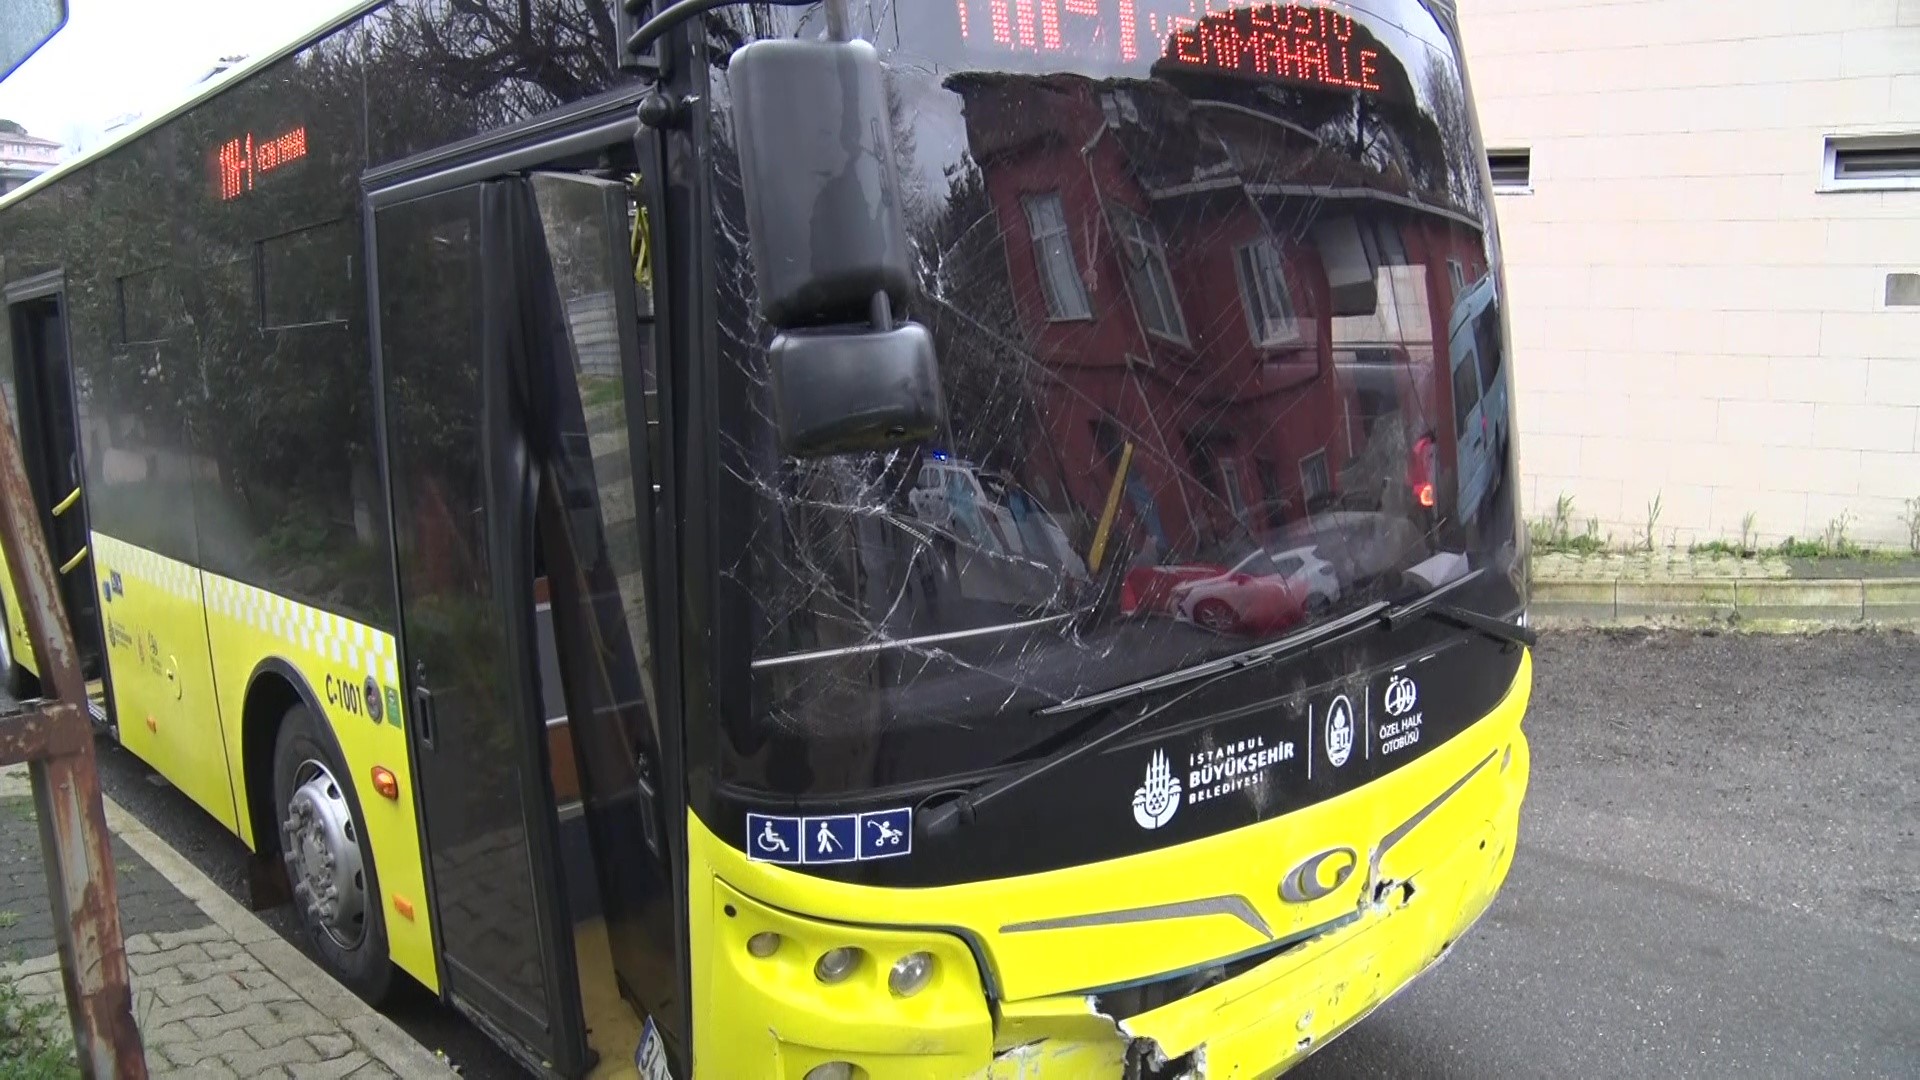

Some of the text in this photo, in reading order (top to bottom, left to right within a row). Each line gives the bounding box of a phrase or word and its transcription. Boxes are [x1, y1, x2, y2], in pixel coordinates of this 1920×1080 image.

[1380, 712, 1423, 740] ÖZEL HALK
[1382, 727, 1420, 755] OTOBÜSÜ
[1189, 741, 1294, 789] BÜYÜKŞEHİR
